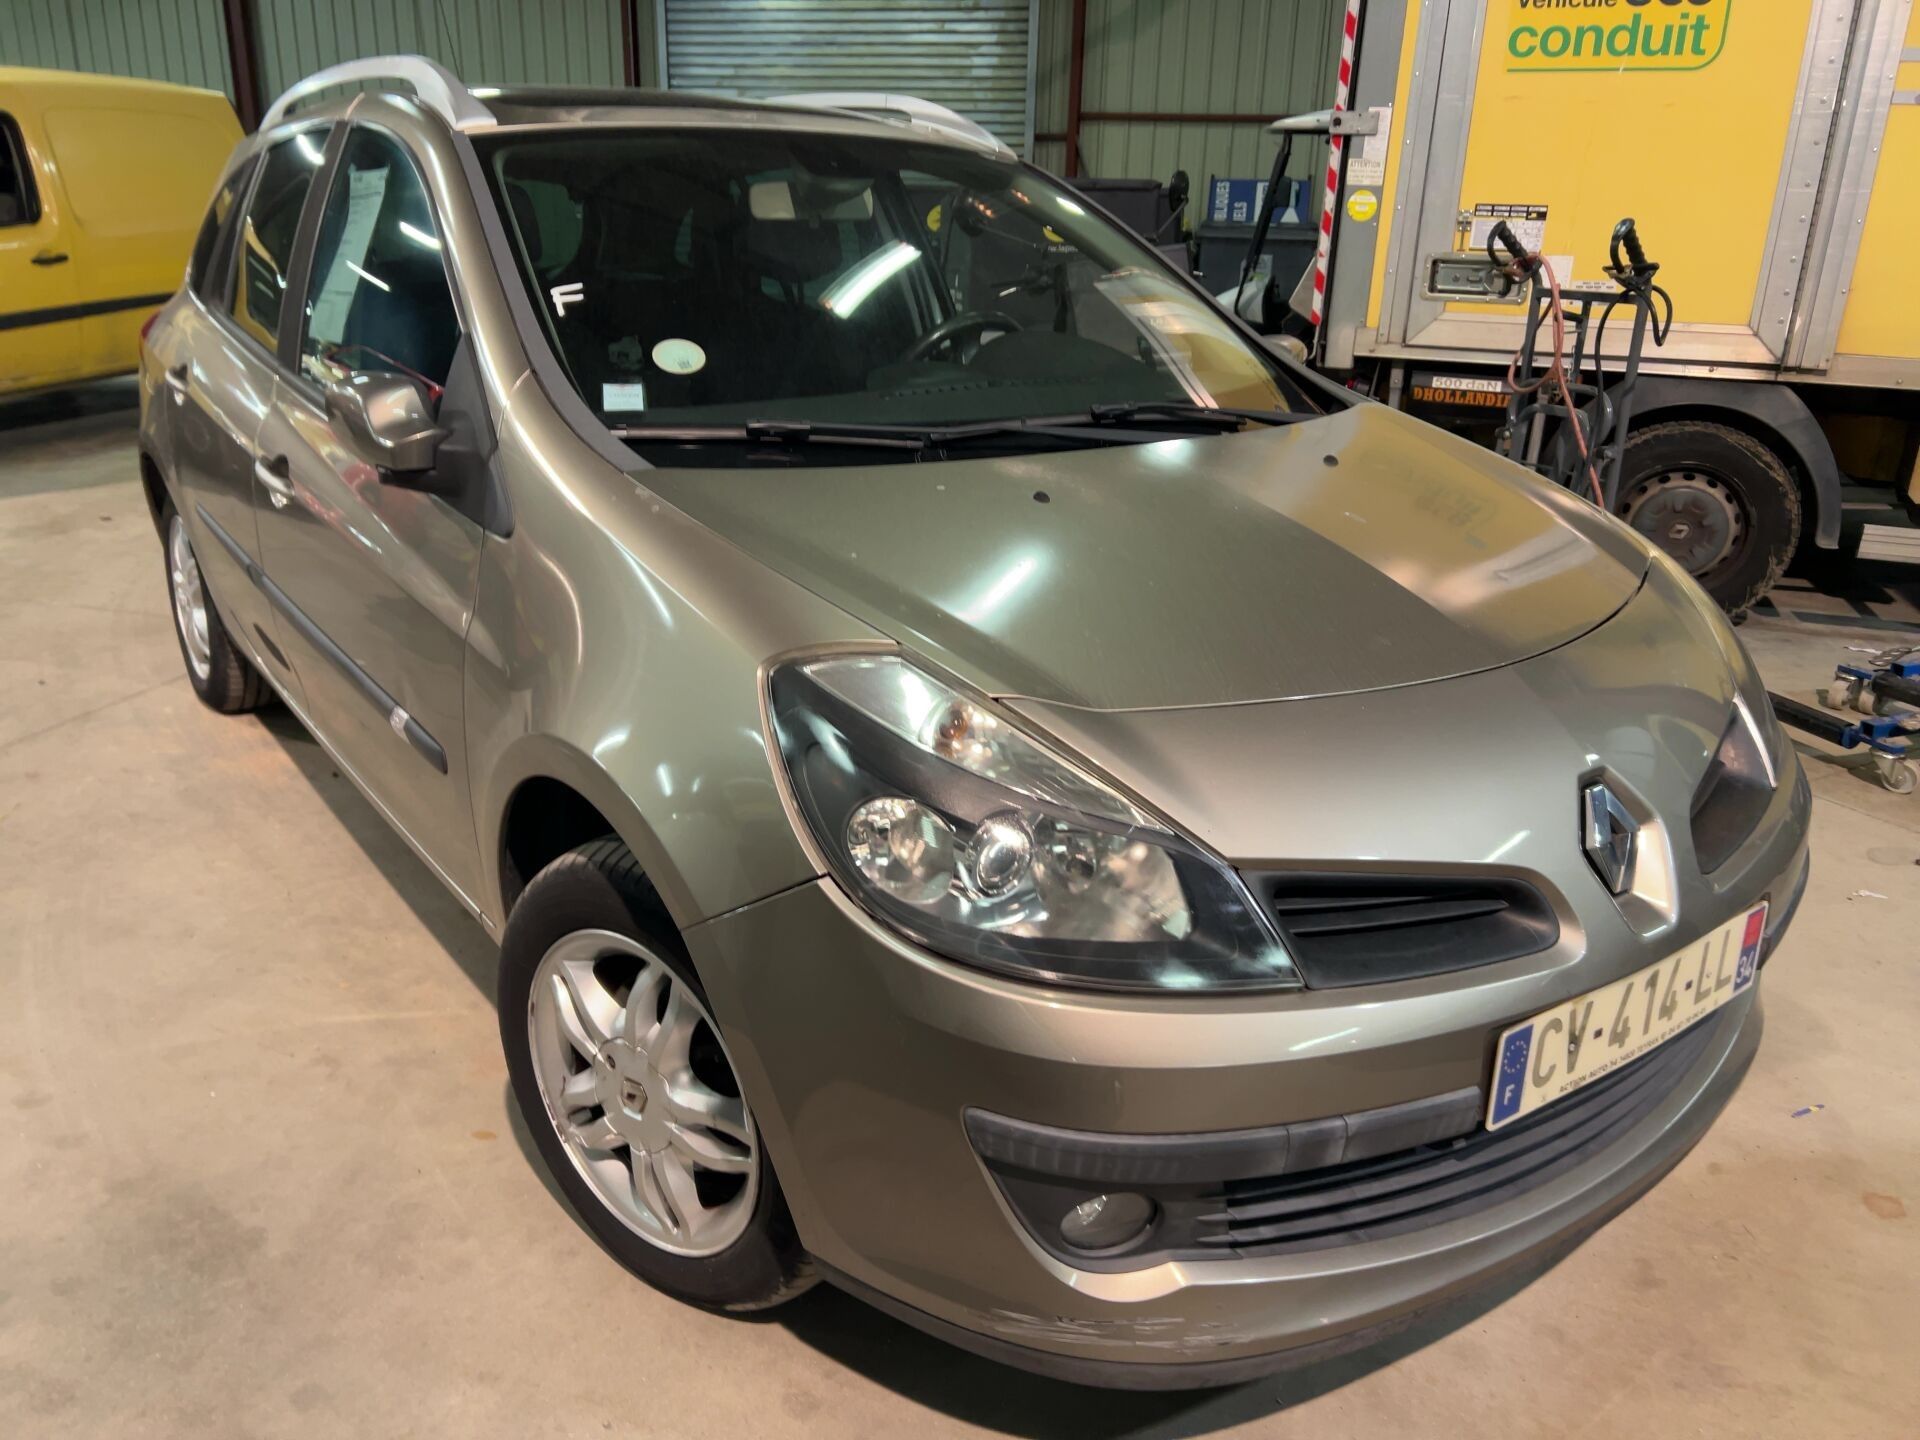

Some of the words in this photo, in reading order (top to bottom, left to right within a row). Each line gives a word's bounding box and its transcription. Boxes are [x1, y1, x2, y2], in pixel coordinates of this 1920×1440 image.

[1508, 12, 1710, 58] conduit
[550, 282, 584, 317] F
[1736, 950, 1754, 984] 34
[1503, 1084, 1515, 1105] F
